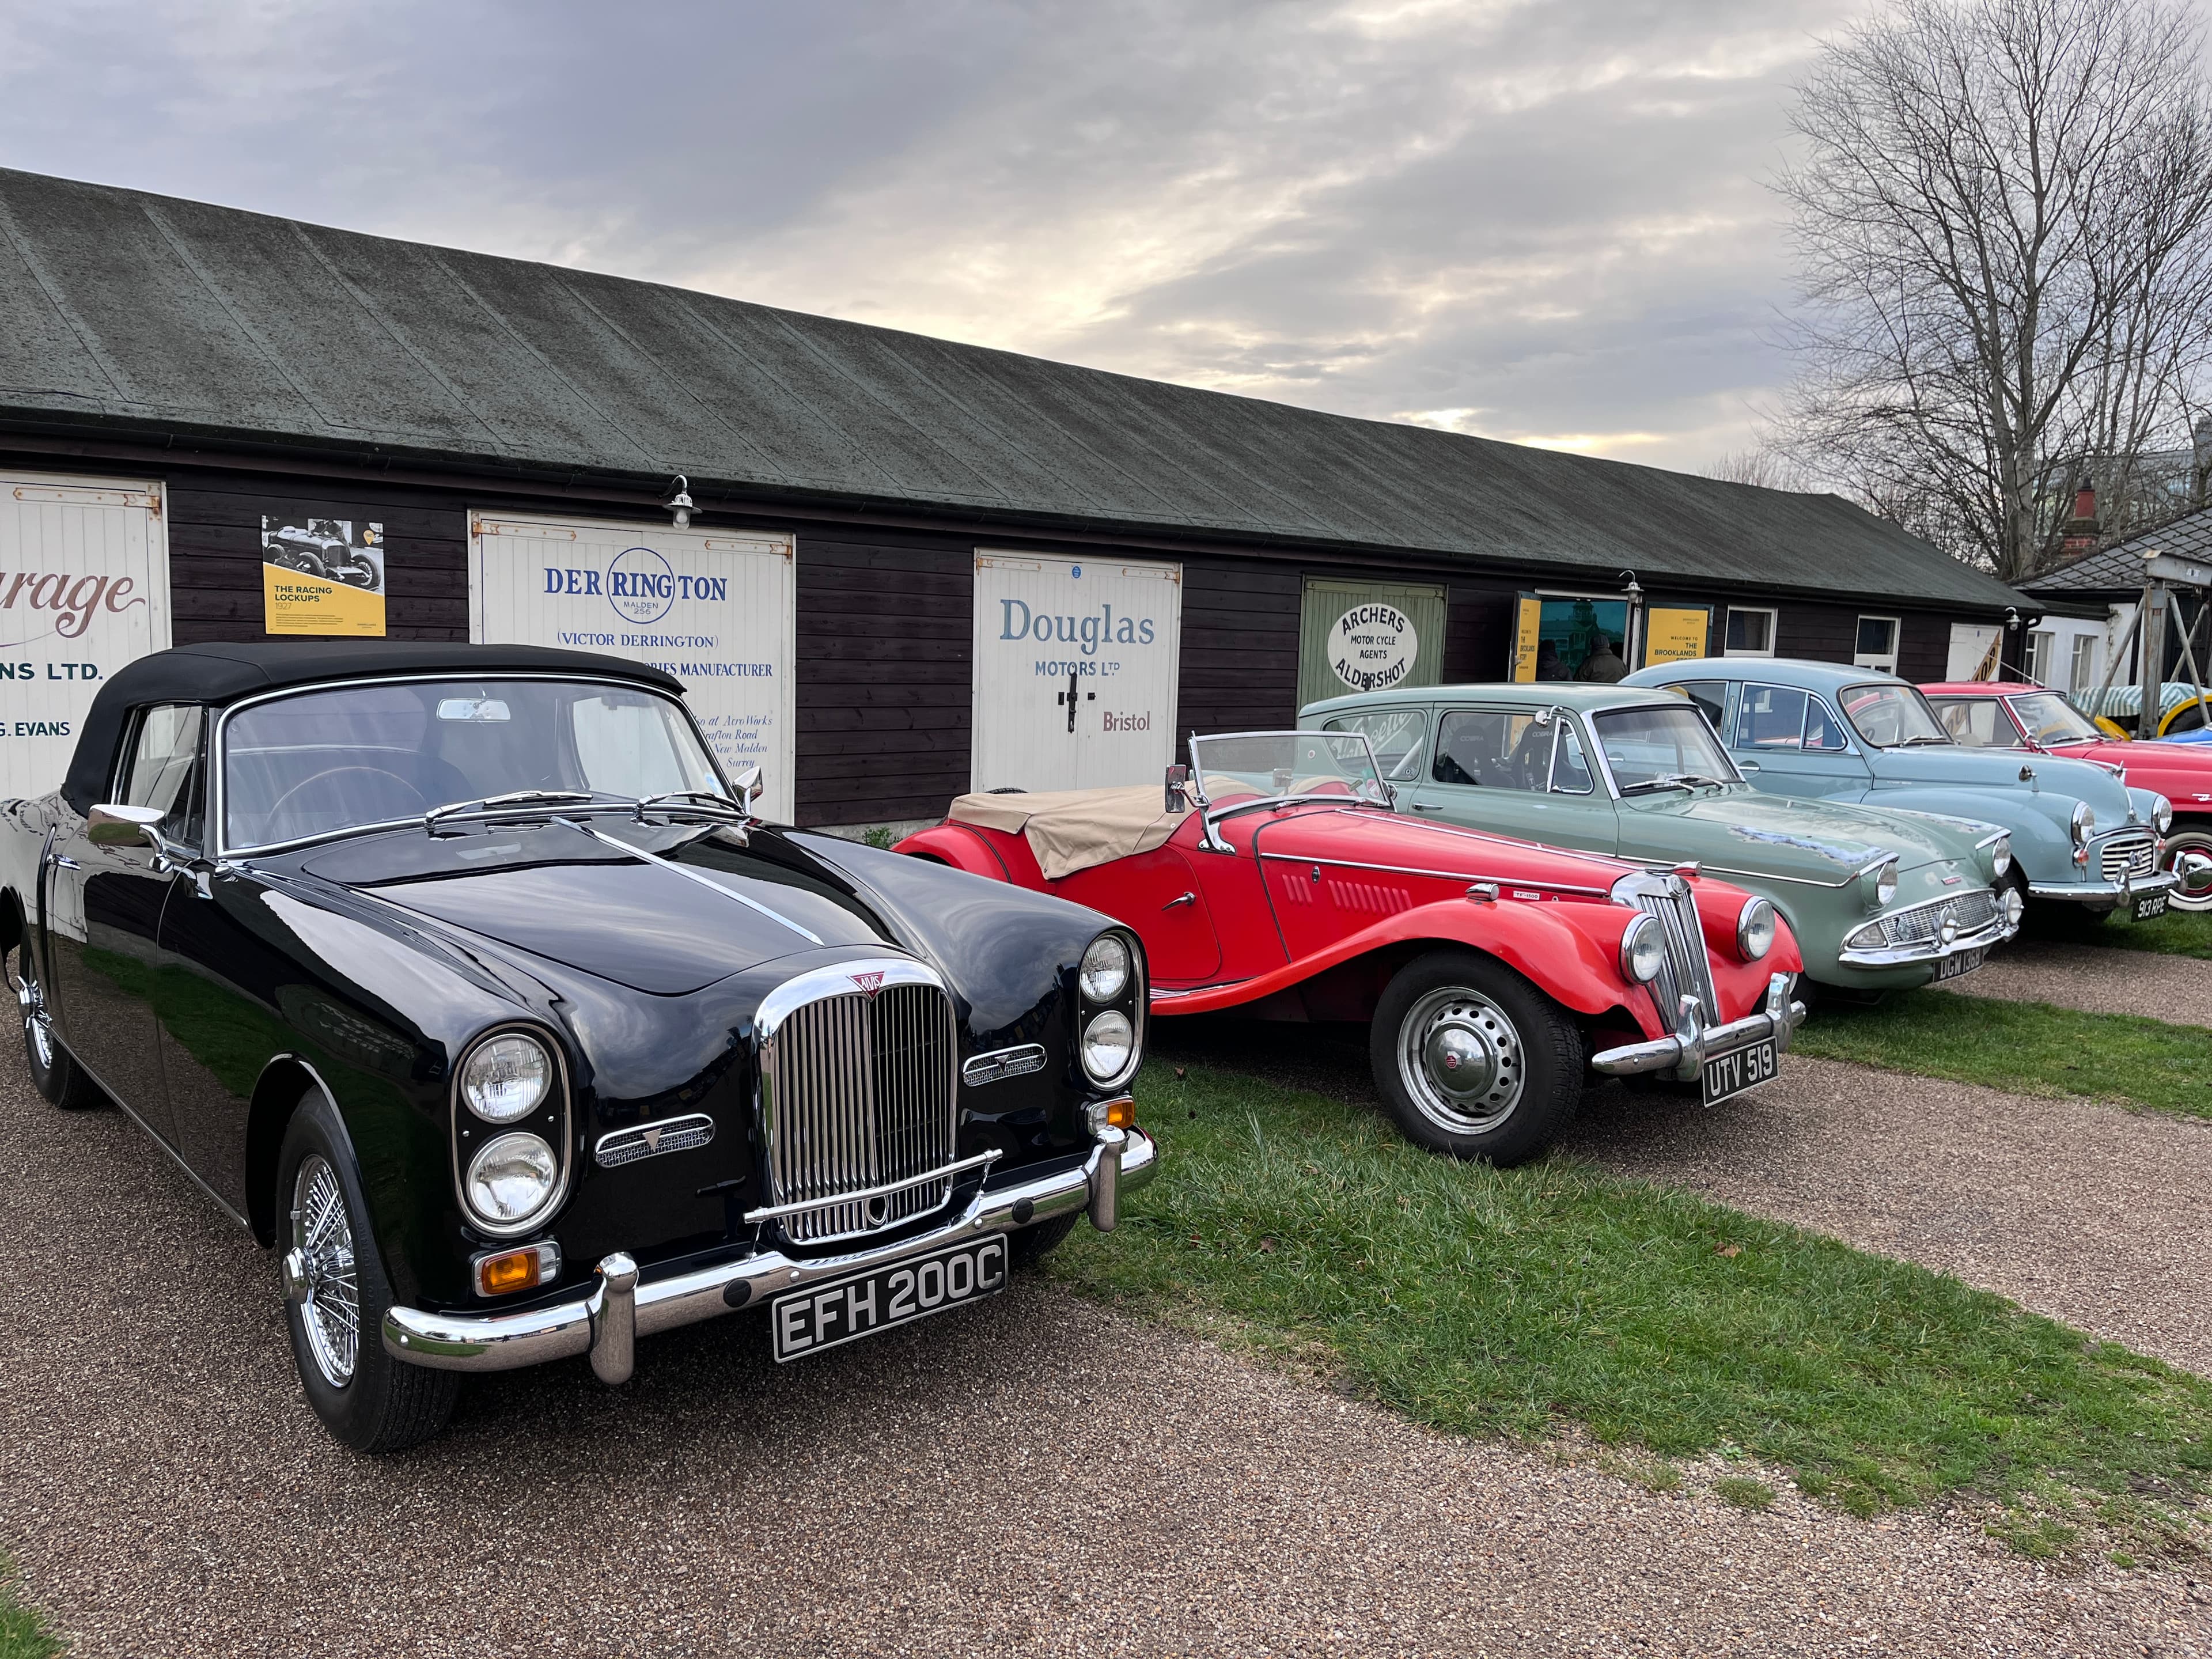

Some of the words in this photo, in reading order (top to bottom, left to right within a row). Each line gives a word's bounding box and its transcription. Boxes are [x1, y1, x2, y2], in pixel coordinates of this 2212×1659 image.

[0, 573, 146, 638] rage
[275, 594, 320, 602] LOCKUPS
[1000, 599, 1154, 655] Douglas
[1342, 607, 1405, 636] ARCHERS
[558, 628, 615, 645] (VICTOR
[621, 634, 719, 649] DERRINGTON)
[1351, 635, 1374, 645] MOTOR
[1377, 636, 1396, 645] CYCLE
[1359, 650, 1387, 659] AGENTS
[47, 663, 103, 680] LTD.
[680, 664, 773, 676] MANUFACTURER
[1035, 661, 1097, 676] MOTORS
[1335, 657, 1406, 688] ALDERSHOT
[15, 721, 70, 736] EVANS
[709, 716, 719, 726] at
[747, 715, 772, 725] Works
[1104, 711, 1150, 731] Bristol
[702, 730, 732, 742] rafton
[735, 729, 758, 740] Road
[714, 744, 732, 753] New
[735, 743, 767, 753] Malden
[726, 757, 755, 768] Surrey
[2138, 899, 2152, 918] 913
[2152, 896, 2166, 915] RPE
[1940, 954, 1961, 979] DGW
[861, 975, 880, 991] ALVIS
[1709, 1054, 1740, 1096] UTV
[1747, 1044, 1772, 1081] 519
[781, 1280, 876, 1353] EFH
[888, 1244, 1002, 1319] 200C
